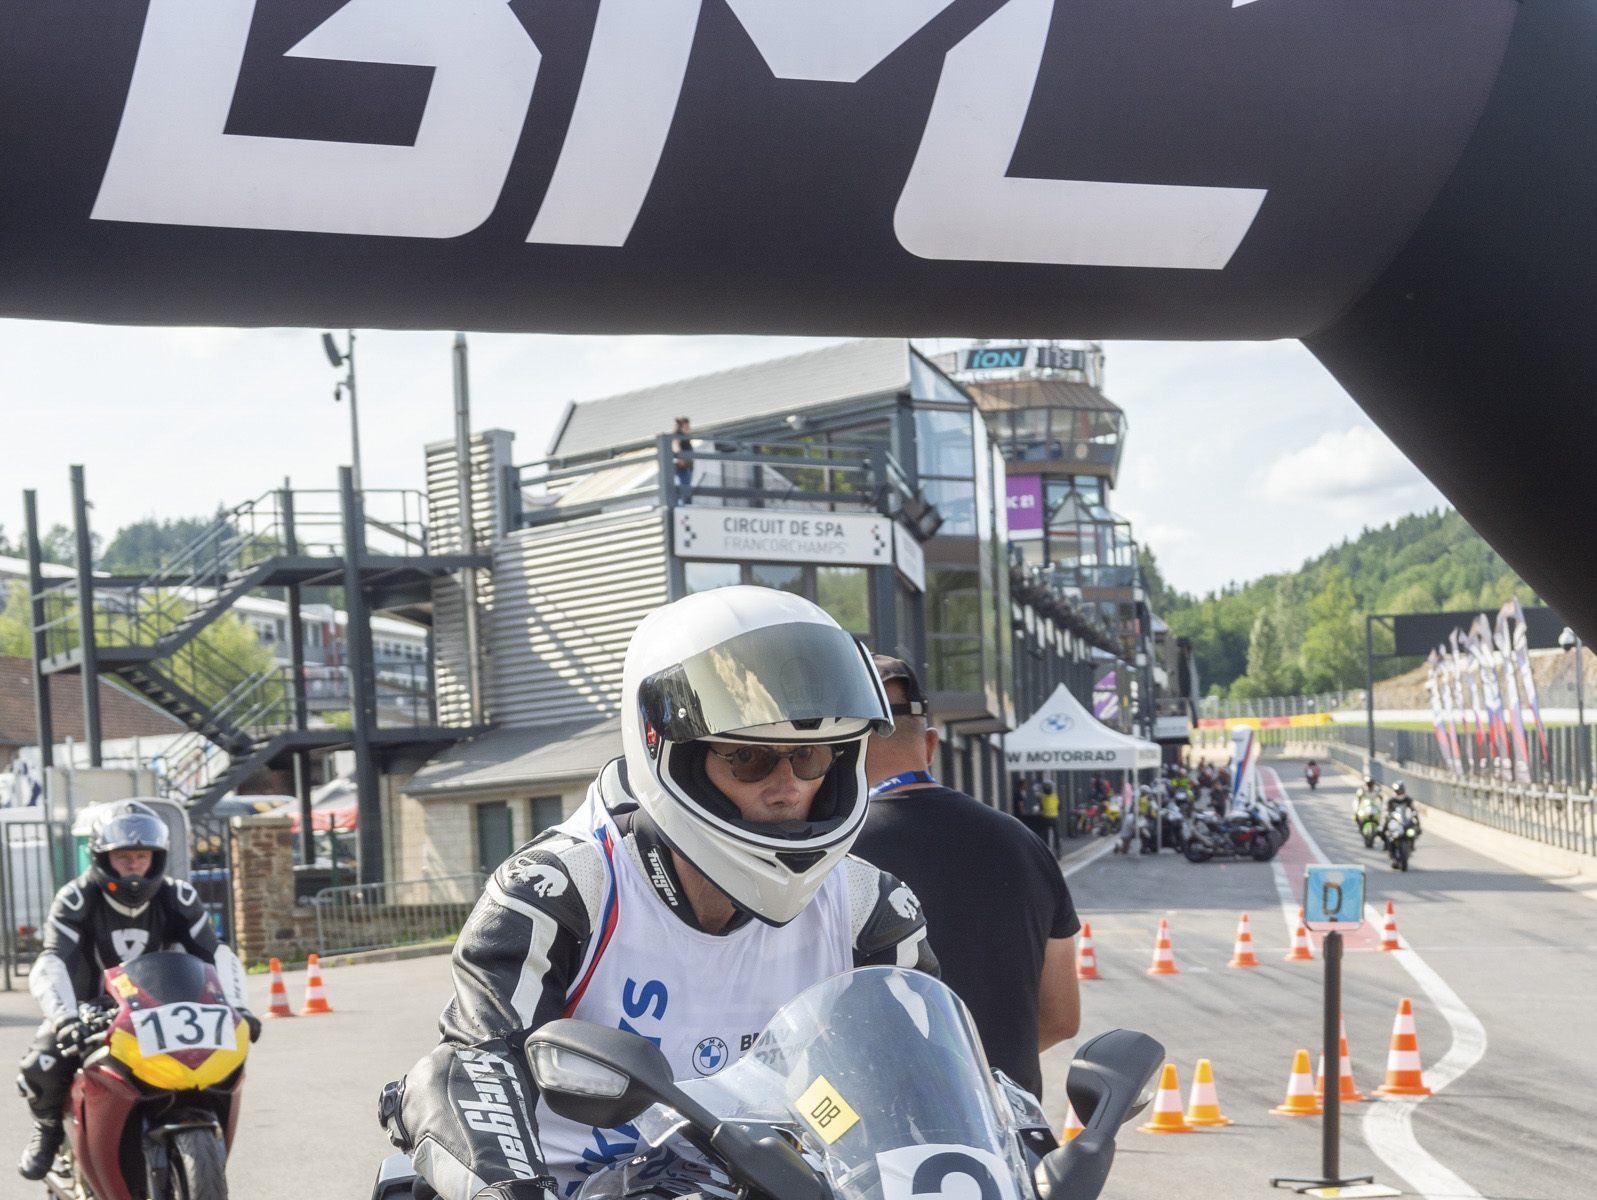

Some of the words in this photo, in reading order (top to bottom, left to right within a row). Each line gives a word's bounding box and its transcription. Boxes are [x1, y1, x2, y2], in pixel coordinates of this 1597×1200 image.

[723, 516, 785, 535] CIRCUIT
[789, 519, 810, 536] DE
[814, 521, 846, 538] SPA
[723, 536, 848, 556] FRANCORCHAMPS
[1026, 749, 1117, 764] MOTORRAD
[141, 1004, 229, 1051] 137
[810, 1095, 842, 1130] DB
